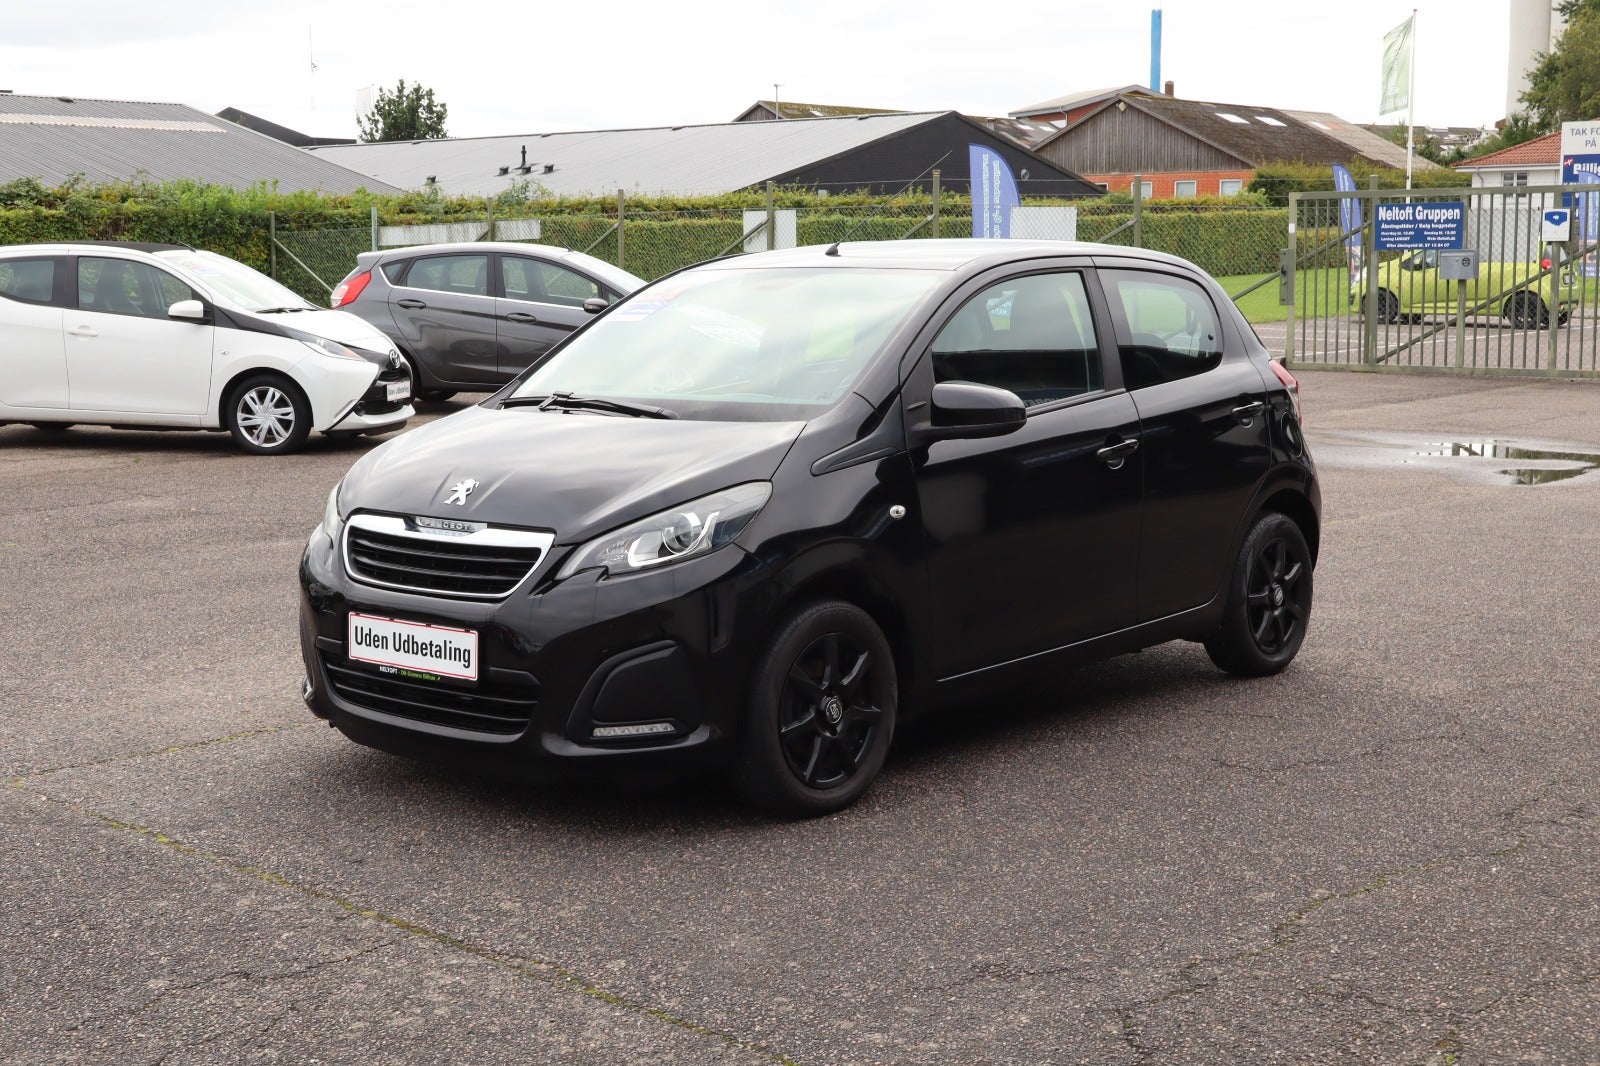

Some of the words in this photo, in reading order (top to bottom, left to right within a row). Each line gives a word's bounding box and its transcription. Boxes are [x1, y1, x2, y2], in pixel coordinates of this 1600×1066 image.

[1570, 128, 1587, 136] TAK
[1585, 137, 1597, 147] PÅ
[1378, 206, 1413, 220] Neltoft
[1415, 205, 1460, 222] Gruppen
[355, 625, 388, 650] Uden
[393, 632, 471, 669] Udbetaling
